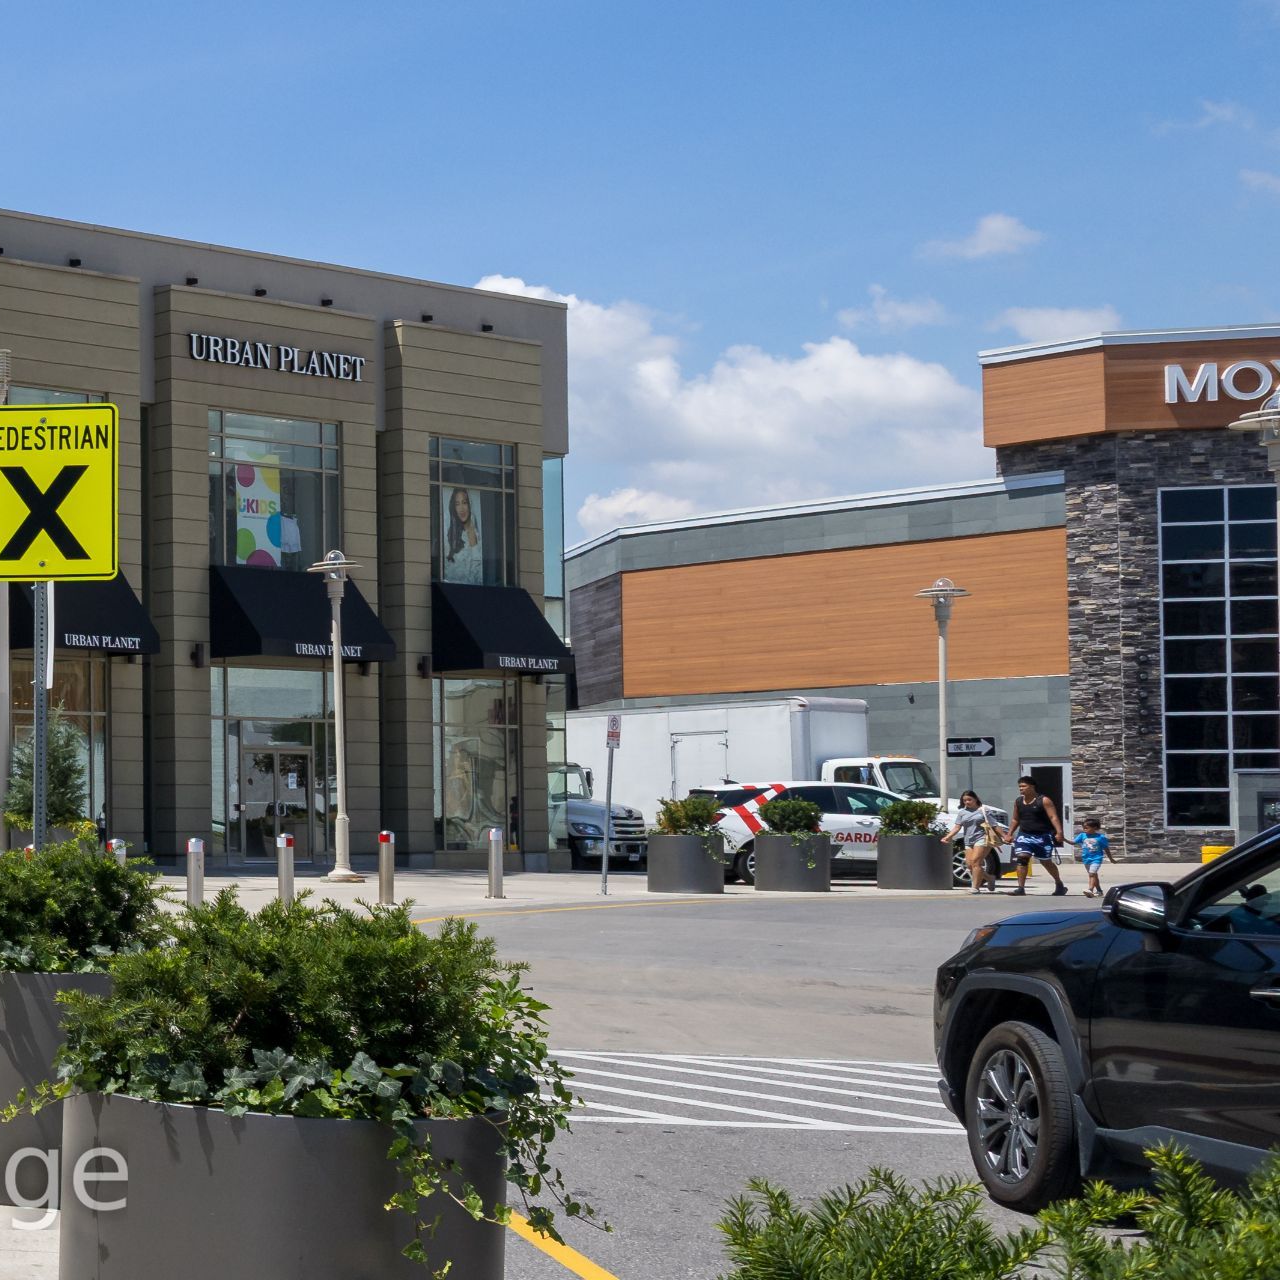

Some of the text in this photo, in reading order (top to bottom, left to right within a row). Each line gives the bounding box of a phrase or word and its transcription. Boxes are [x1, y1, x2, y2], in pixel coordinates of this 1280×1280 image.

[189, 333, 365, 382] URBAN PLANET
[1164, 360, 1280, 404] MO
[64, 633, 140, 649] URBAN PLANET
[295, 643, 362, 657] URBAN PANET
[499, 656, 559, 670] URBAN PLANET
[965, 743, 977, 751] WAY
